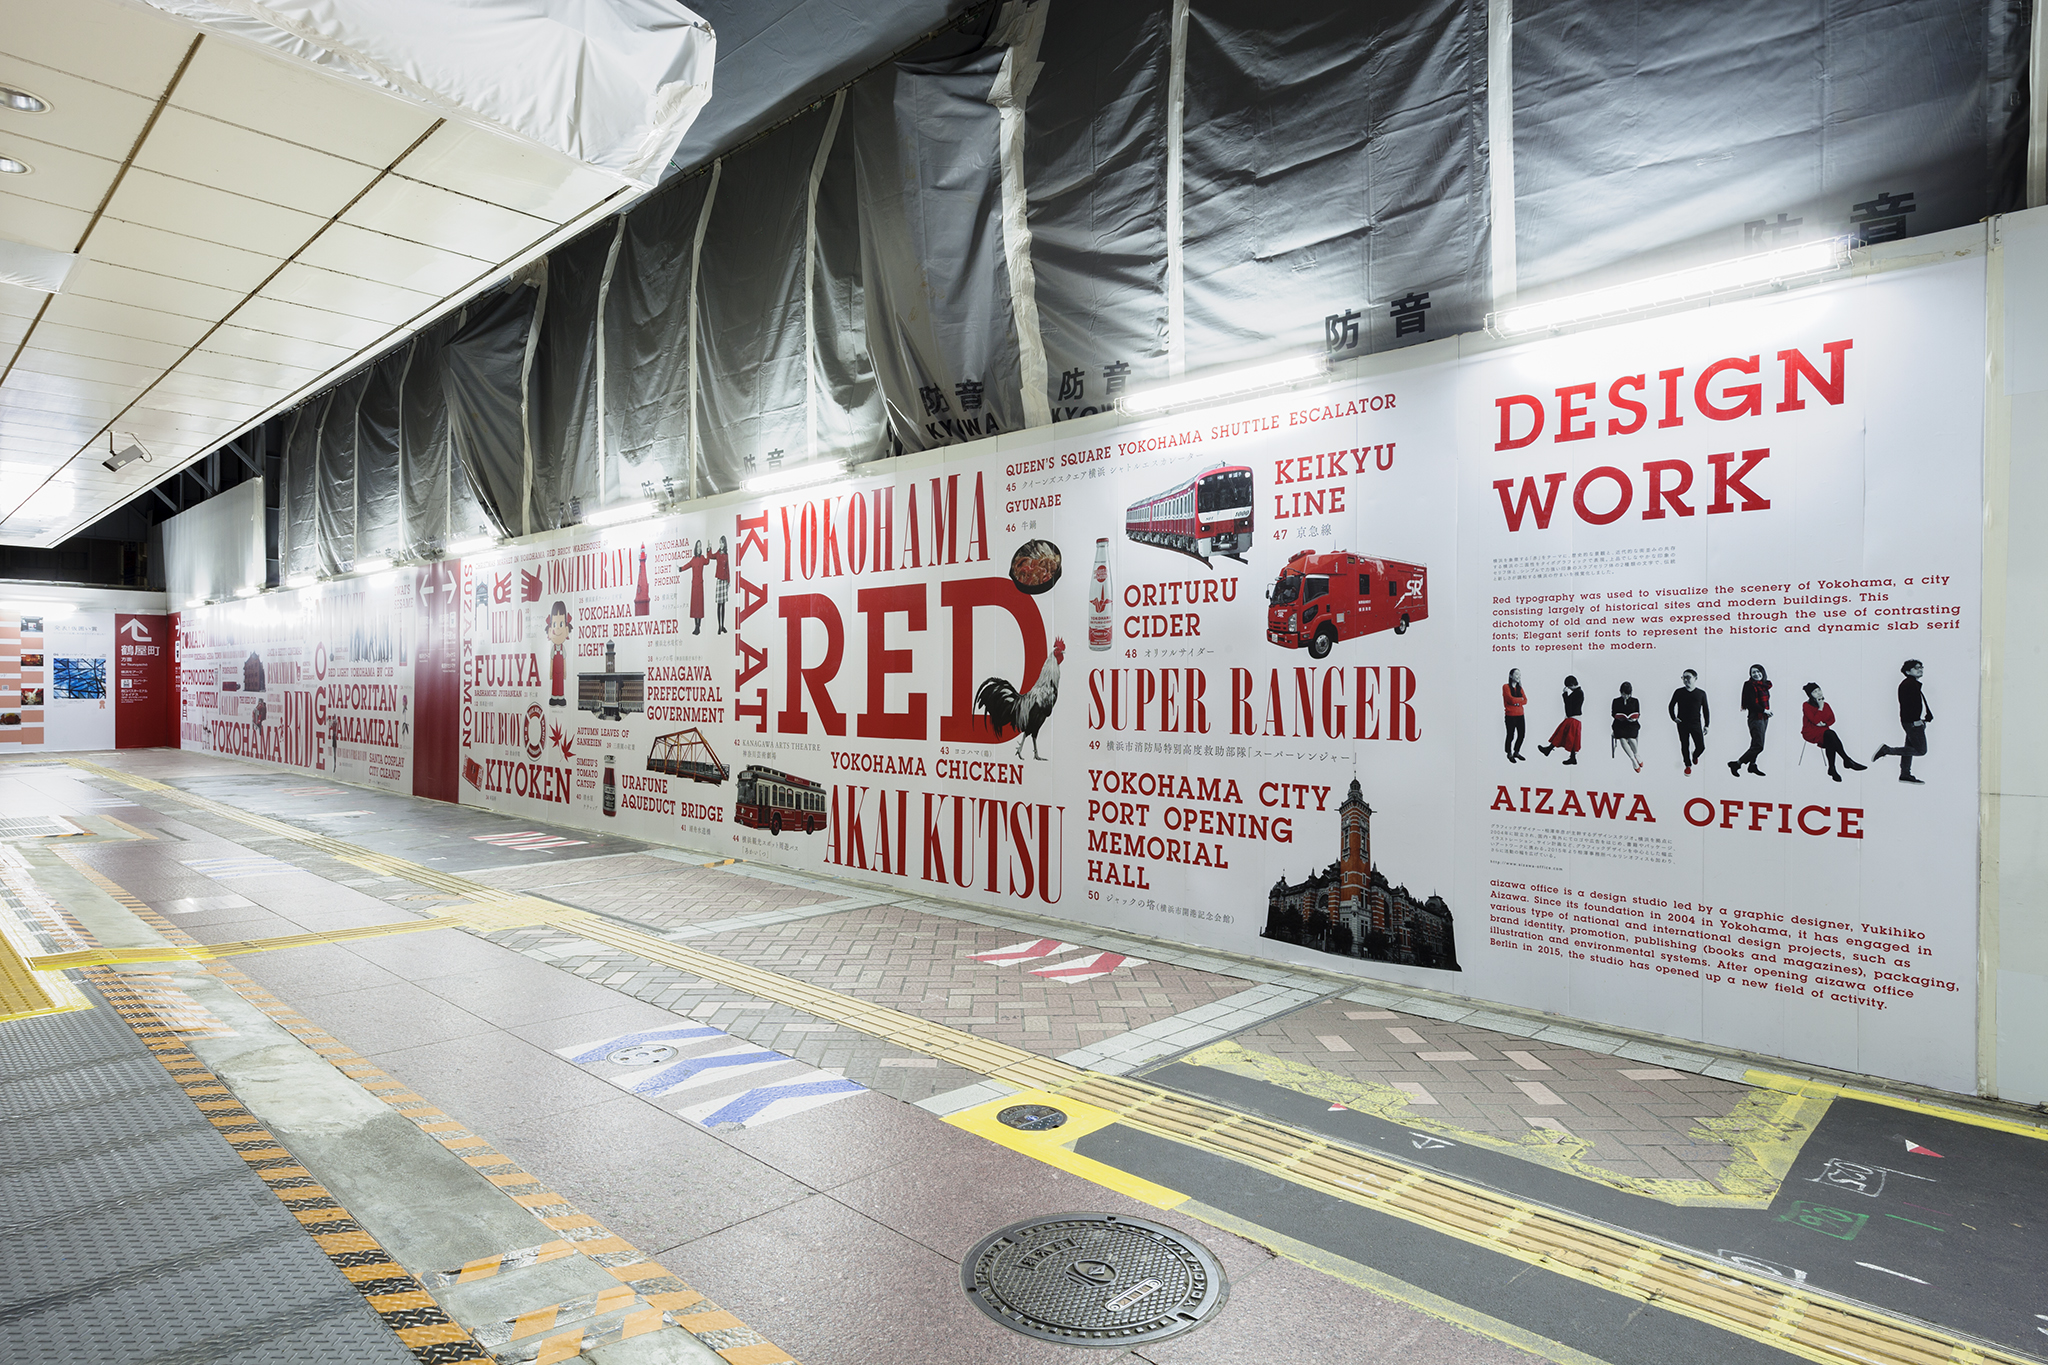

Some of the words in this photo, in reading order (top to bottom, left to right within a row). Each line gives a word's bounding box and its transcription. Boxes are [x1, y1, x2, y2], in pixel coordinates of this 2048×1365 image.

[1325, 293, 1431, 352] 防音
[1060, 361, 1131, 400] 防音
[1494, 338, 1853, 452] DESIGN
[1006, 458, 1055, 477] QUEEN'S
[1060, 445, 1112, 469] SQUARE
[1118, 429, 1203, 457] YOKOHAMA
[1211, 414, 1279, 440] SHUTTLE
[1289, 393, 1397, 425] ESCALATOR
[1274, 443, 1397, 485] KEIKYU
[1006, 481, 1017, 492] 45
[1493, 448, 1771, 532] WORK
[1006, 494, 1061, 513] GYUNABE
[1274, 487, 1346, 520] LINE
[780, 471, 991, 582] YOKOHAMA
[1006, 523, 1017, 533] 46
[1273, 530, 1288, 540] 47
[1296, 524, 1332, 538] 京急線
[654, 537, 690, 551] YOKOHAMA
[654, 549, 693, 563] MOTOMACHI
[547, 547, 633, 596] YOSHIMURAYA
[654, 564, 672, 575] LIGHT
[654, 575, 681, 587] PHOENIX
[1123, 577, 1238, 607] ORITURU
[1493, 596, 1510, 604] Red
[1516, 593, 1574, 604] typography
[1607, 590, 1632, 598] used
[1656, 587, 1708, 596] visualize
[1741, 584, 1791, 592] scenery
[1798, 581, 1810, 590] of
[1818, 579, 1896, 589] Yokohama,
[1922, 575, 1950, 585] city
[578, 604, 632, 621] YOKOHAMA
[735, 510, 769, 733] KAAT
[1124, 613, 1201, 639] CIDER
[578, 623, 609, 639] NORTH
[613, 619, 679, 637] BREAKWATER
[578, 643, 605, 657] LIGHT
[778, 577, 1050, 744] RED
[1124, 649, 1138, 659] 48
[474, 653, 542, 687] FUJIYA
[647, 666, 712, 682] KANAGAWA
[327, 683, 398, 712] NAPORITAN
[647, 686, 723, 703] PREFECTURAL
[1088, 667, 1211, 734] SUPER
[1229, 665, 1422, 742] RANGER
[647, 705, 725, 723] GOVERNMENT
[211, 719, 282, 763] YOKOHAMA
[284, 691, 313, 768] RED
[474, 711, 496, 744] LIFE
[498, 712, 523, 747] BUOY
[577, 727, 600, 736] AUTUMN
[601, 728, 620, 738] LEAVES
[621, 729, 630, 738] OF
[743, 739, 774, 748] KANAGAWA
[792, 742, 822, 751] THEATRE
[940, 746, 949, 755] 43
[1089, 741, 1101, 750] 49
[368, 765, 379, 776] CITY
[485, 758, 573, 804] KIYOKEN
[576, 768, 599, 779] TOMATO
[831, 751, 927, 777] YOKOHAMA
[935, 758, 1024, 785] CHICKEN
[576, 779, 597, 789] CATSUP
[622, 774, 668, 795] URAFUNE
[1088, 769, 1243, 804] YOKOHAMA
[1259, 781, 1331, 811] CITY
[621, 794, 676, 817] AQUEDUCT
[680, 802, 724, 823] BRIDGE
[1088, 800, 1150, 827] PORT
[1164, 806, 1293, 844] OPENING
[1490, 785, 1656, 823] AIZAWA
[1683, 797, 1864, 839] OFFICE
[823, 784, 910, 877] AKAI
[920, 792, 1065, 905] KUTSU
[1088, 830, 1229, 869] MEMORIAL
[1088, 859, 1150, 890] HALL
[1088, 891, 1100, 901] 50
[1490, 880, 1525, 889] aizawa
[1531, 884, 1558, 893] office
[1590, 891, 1626, 903] design
[1633, 897, 1667, 907] studio
[1674, 901, 1692, 910] led
[1698, 904, 1713, 915] by
[1734, 910, 1783, 922] graphic
[1791, 915, 1853, 932] designer,
[1861, 924, 1925, 939] Yukihiko
[1490, 938, 1517, 949] Berlin
[1523, 943, 1532, 951] in
[1538, 945, 1563, 957] 2015,
[1569, 951, 1585, 959] the
[1590, 955, 1623, 966] studio
[1630, 960, 1649, 970] has
[1656, 966, 1699, 978] opened
[1706, 974, 1721, 983] up
[1742, 979, 1768, 989] new
[1775, 983, 1804, 995] field
[1811, 990, 1823, 998] of
[1831, 994, 1887, 1010] activity.
